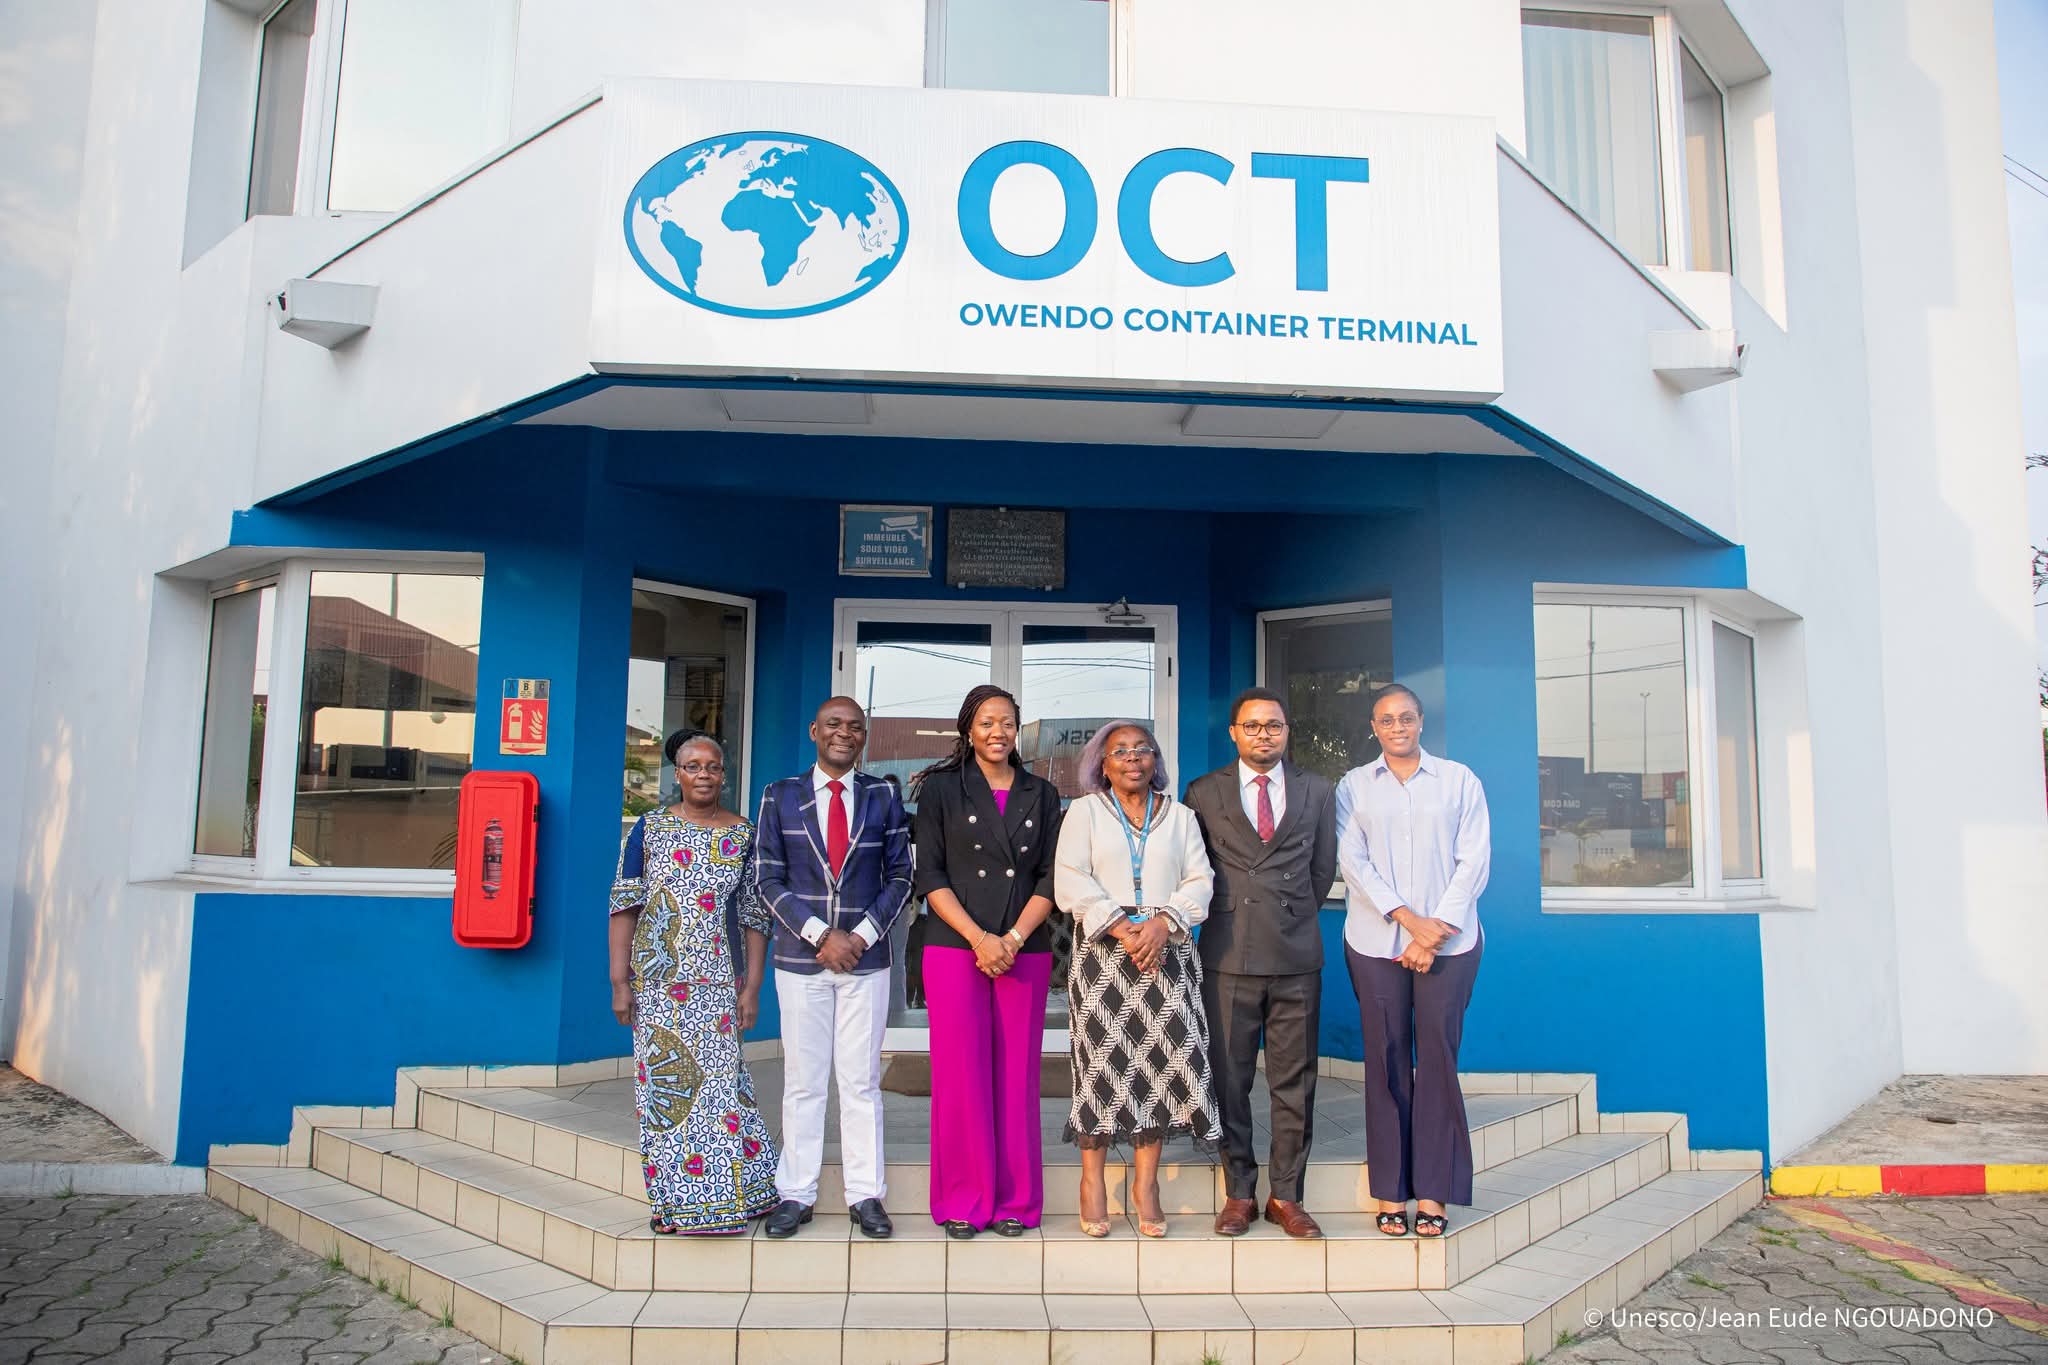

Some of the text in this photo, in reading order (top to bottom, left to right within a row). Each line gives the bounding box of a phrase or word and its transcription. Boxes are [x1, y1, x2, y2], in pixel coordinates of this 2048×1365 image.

[956, 139, 1370, 292] OCT
[959, 302, 1478, 347] OWENDO CONTAINER TERMINAL
[863, 533, 906, 542] IMMEUBLE
[860, 544, 882, 553] SOUS
[855, 556, 915, 566] SURVEILLANCE
[523, 682, 530, 691] B
